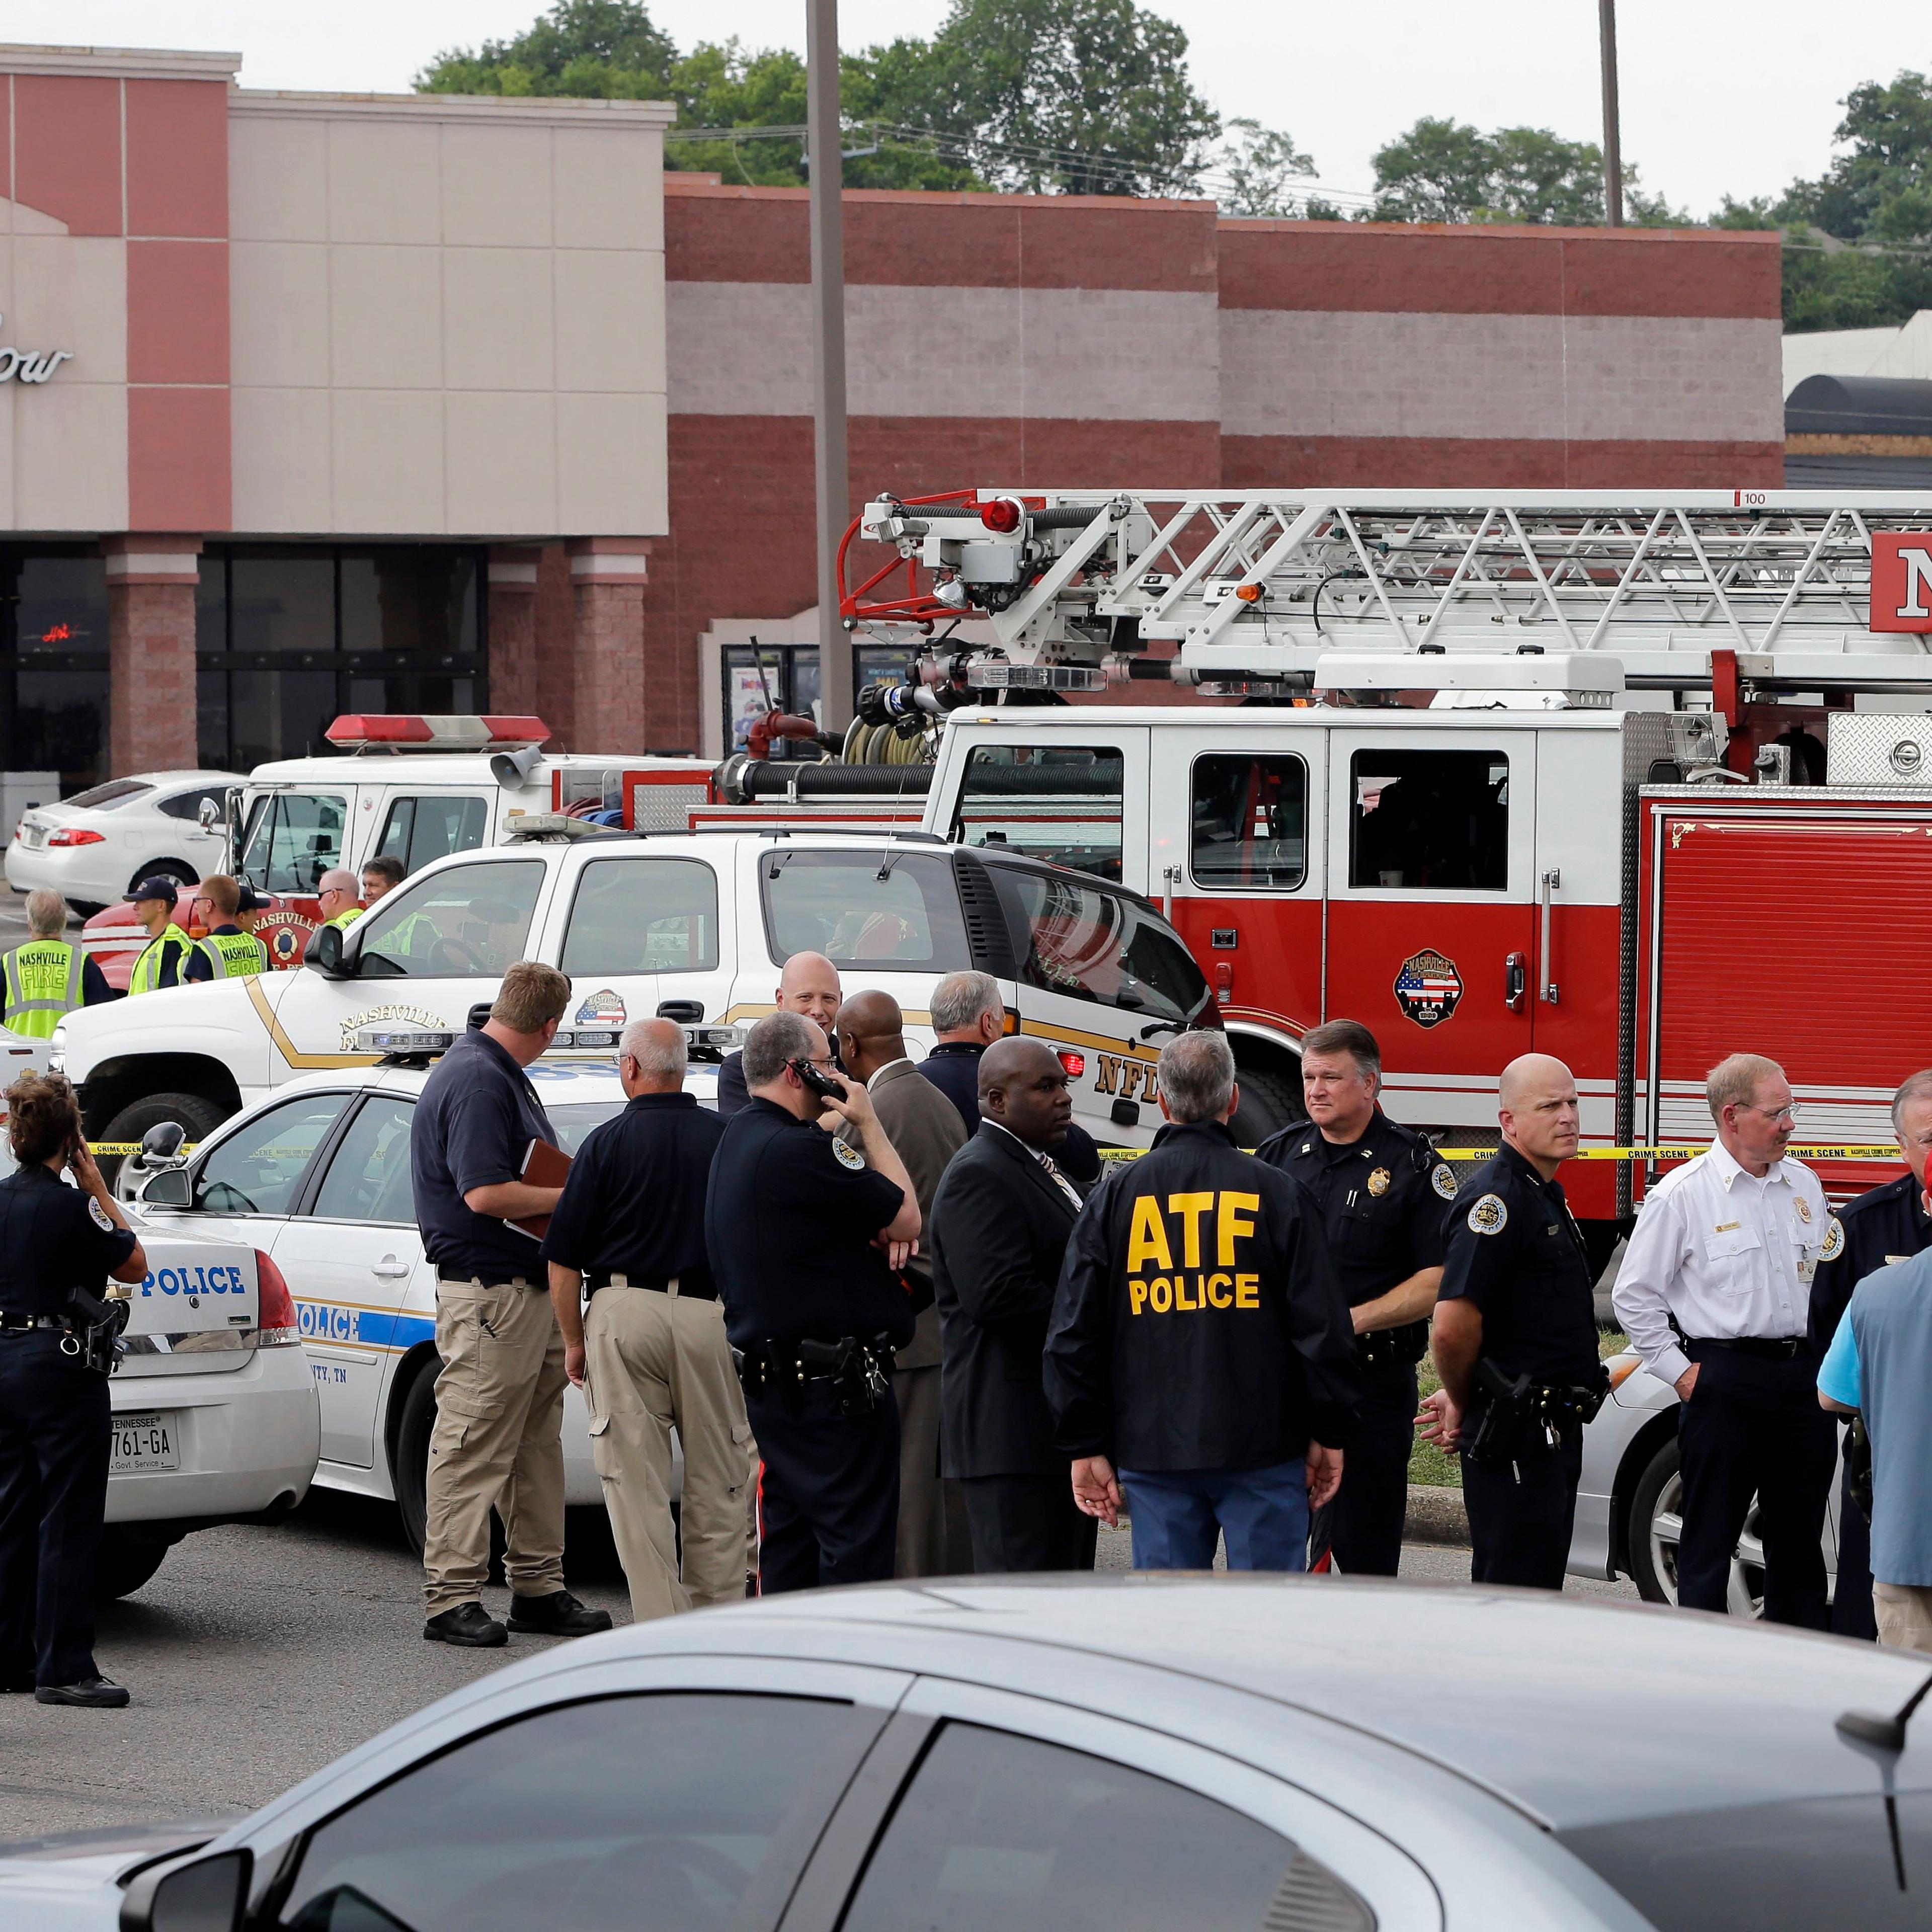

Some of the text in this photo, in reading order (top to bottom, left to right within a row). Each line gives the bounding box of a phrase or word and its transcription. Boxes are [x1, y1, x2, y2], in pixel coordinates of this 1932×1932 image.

[1744, 493, 1765, 505] 100
[19, 952, 67, 966] NASHVILLE
[222, 945, 259, 962] NASHVILLE
[1409, 956, 1450, 973] NASHVILLE
[20, 964, 66, 990] FIRE
[1094, 1054, 1159, 1104] NFD
[1474, 1151, 1497, 1159] CRIM
[1785, 1149, 1814, 1157] CRIME
[1817, 1149, 1846, 1157] SCENE
[1476, 1210, 1498, 1222] POLICE
[1127, 1190, 1260, 1273] ATF
[141, 1266, 246, 1297] POLICE
[1129, 1273, 1260, 1315] POLICE
[334, 1367, 347, 1384] TN
[112, 1417, 156, 1429] TENNESSEE
[112, 1428, 171, 1457] 761-GA
[135, 1460, 159, 1468] Service
